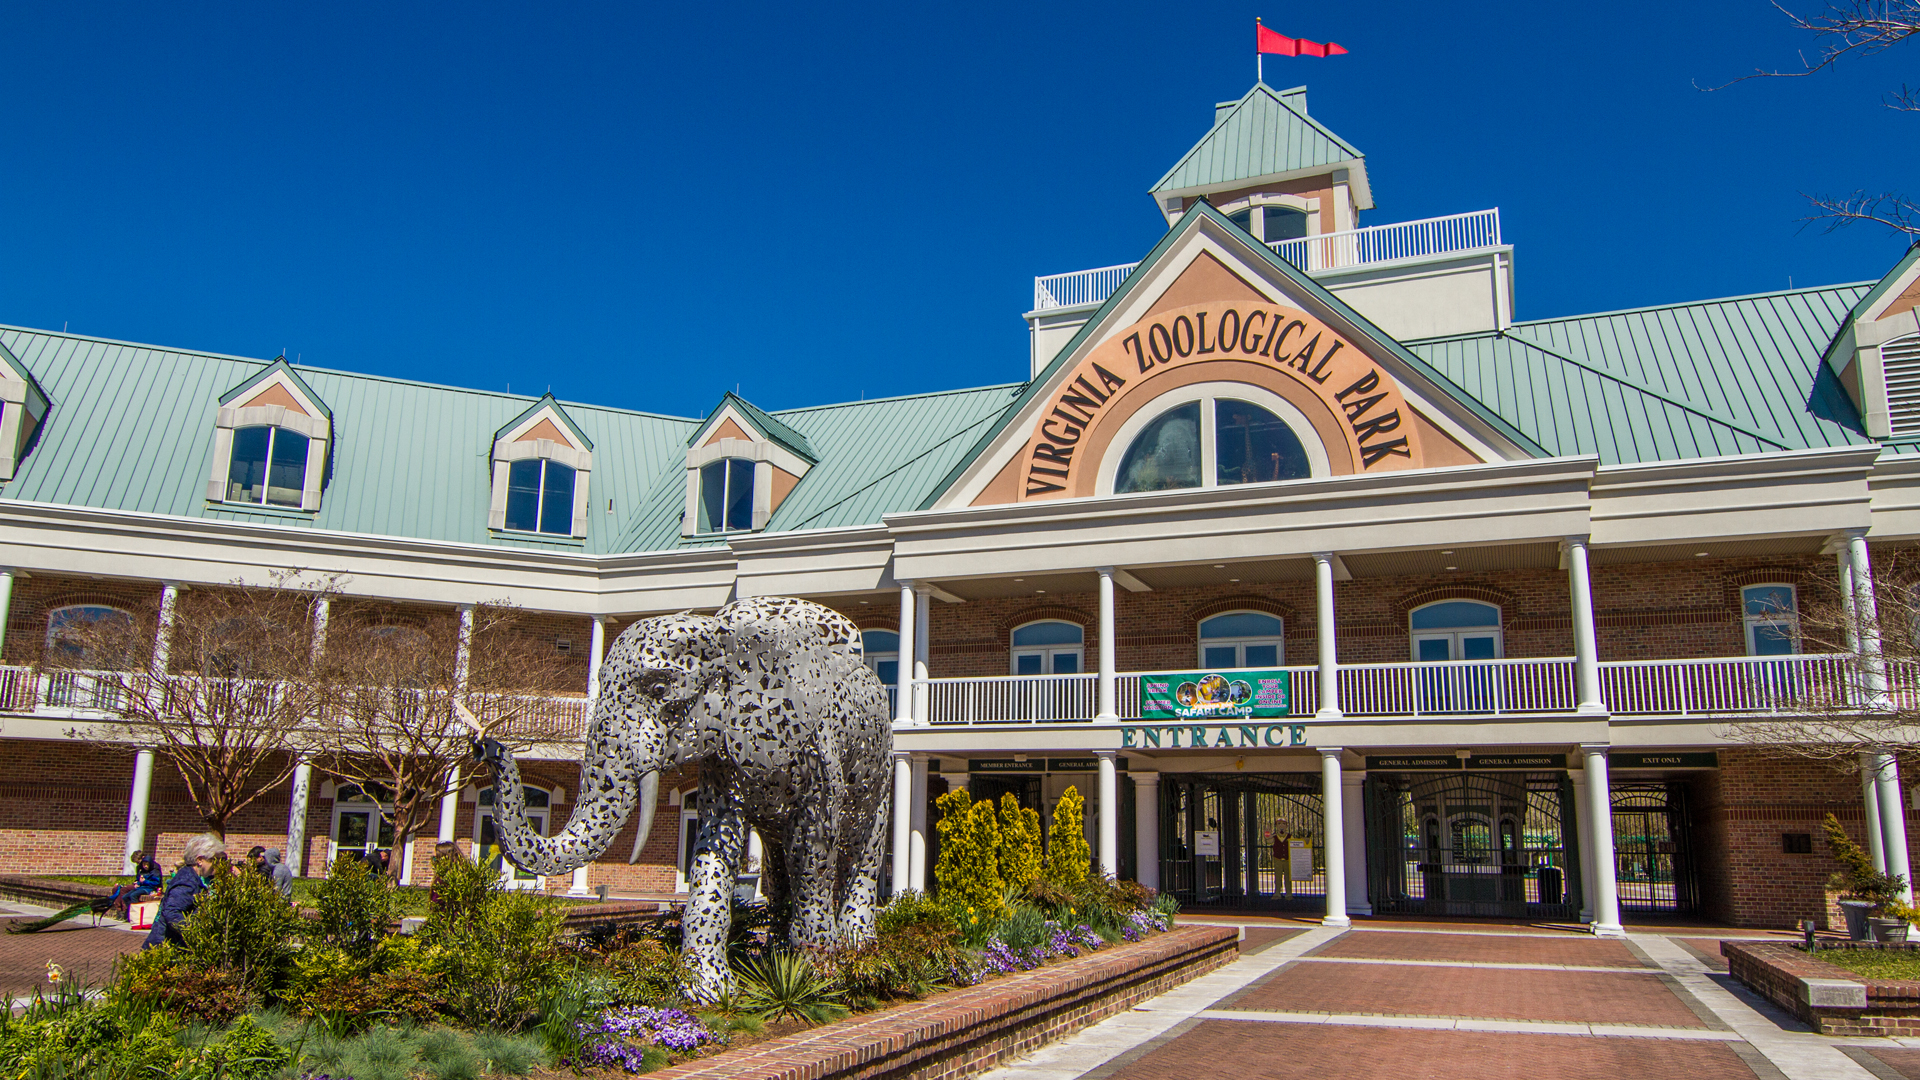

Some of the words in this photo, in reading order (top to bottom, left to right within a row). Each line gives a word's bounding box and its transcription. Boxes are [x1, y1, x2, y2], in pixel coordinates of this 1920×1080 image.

[1026, 361, 1127, 498] VIRGINIA
[1122, 308, 1344, 386] ZOOLOGICAL
[1334, 368, 1411, 471] PARK
[1175, 707, 1216, 717] SAFARI
[1218, 706, 1253, 716] CAMP
[1121, 724, 1307, 749] ENTRANCE
